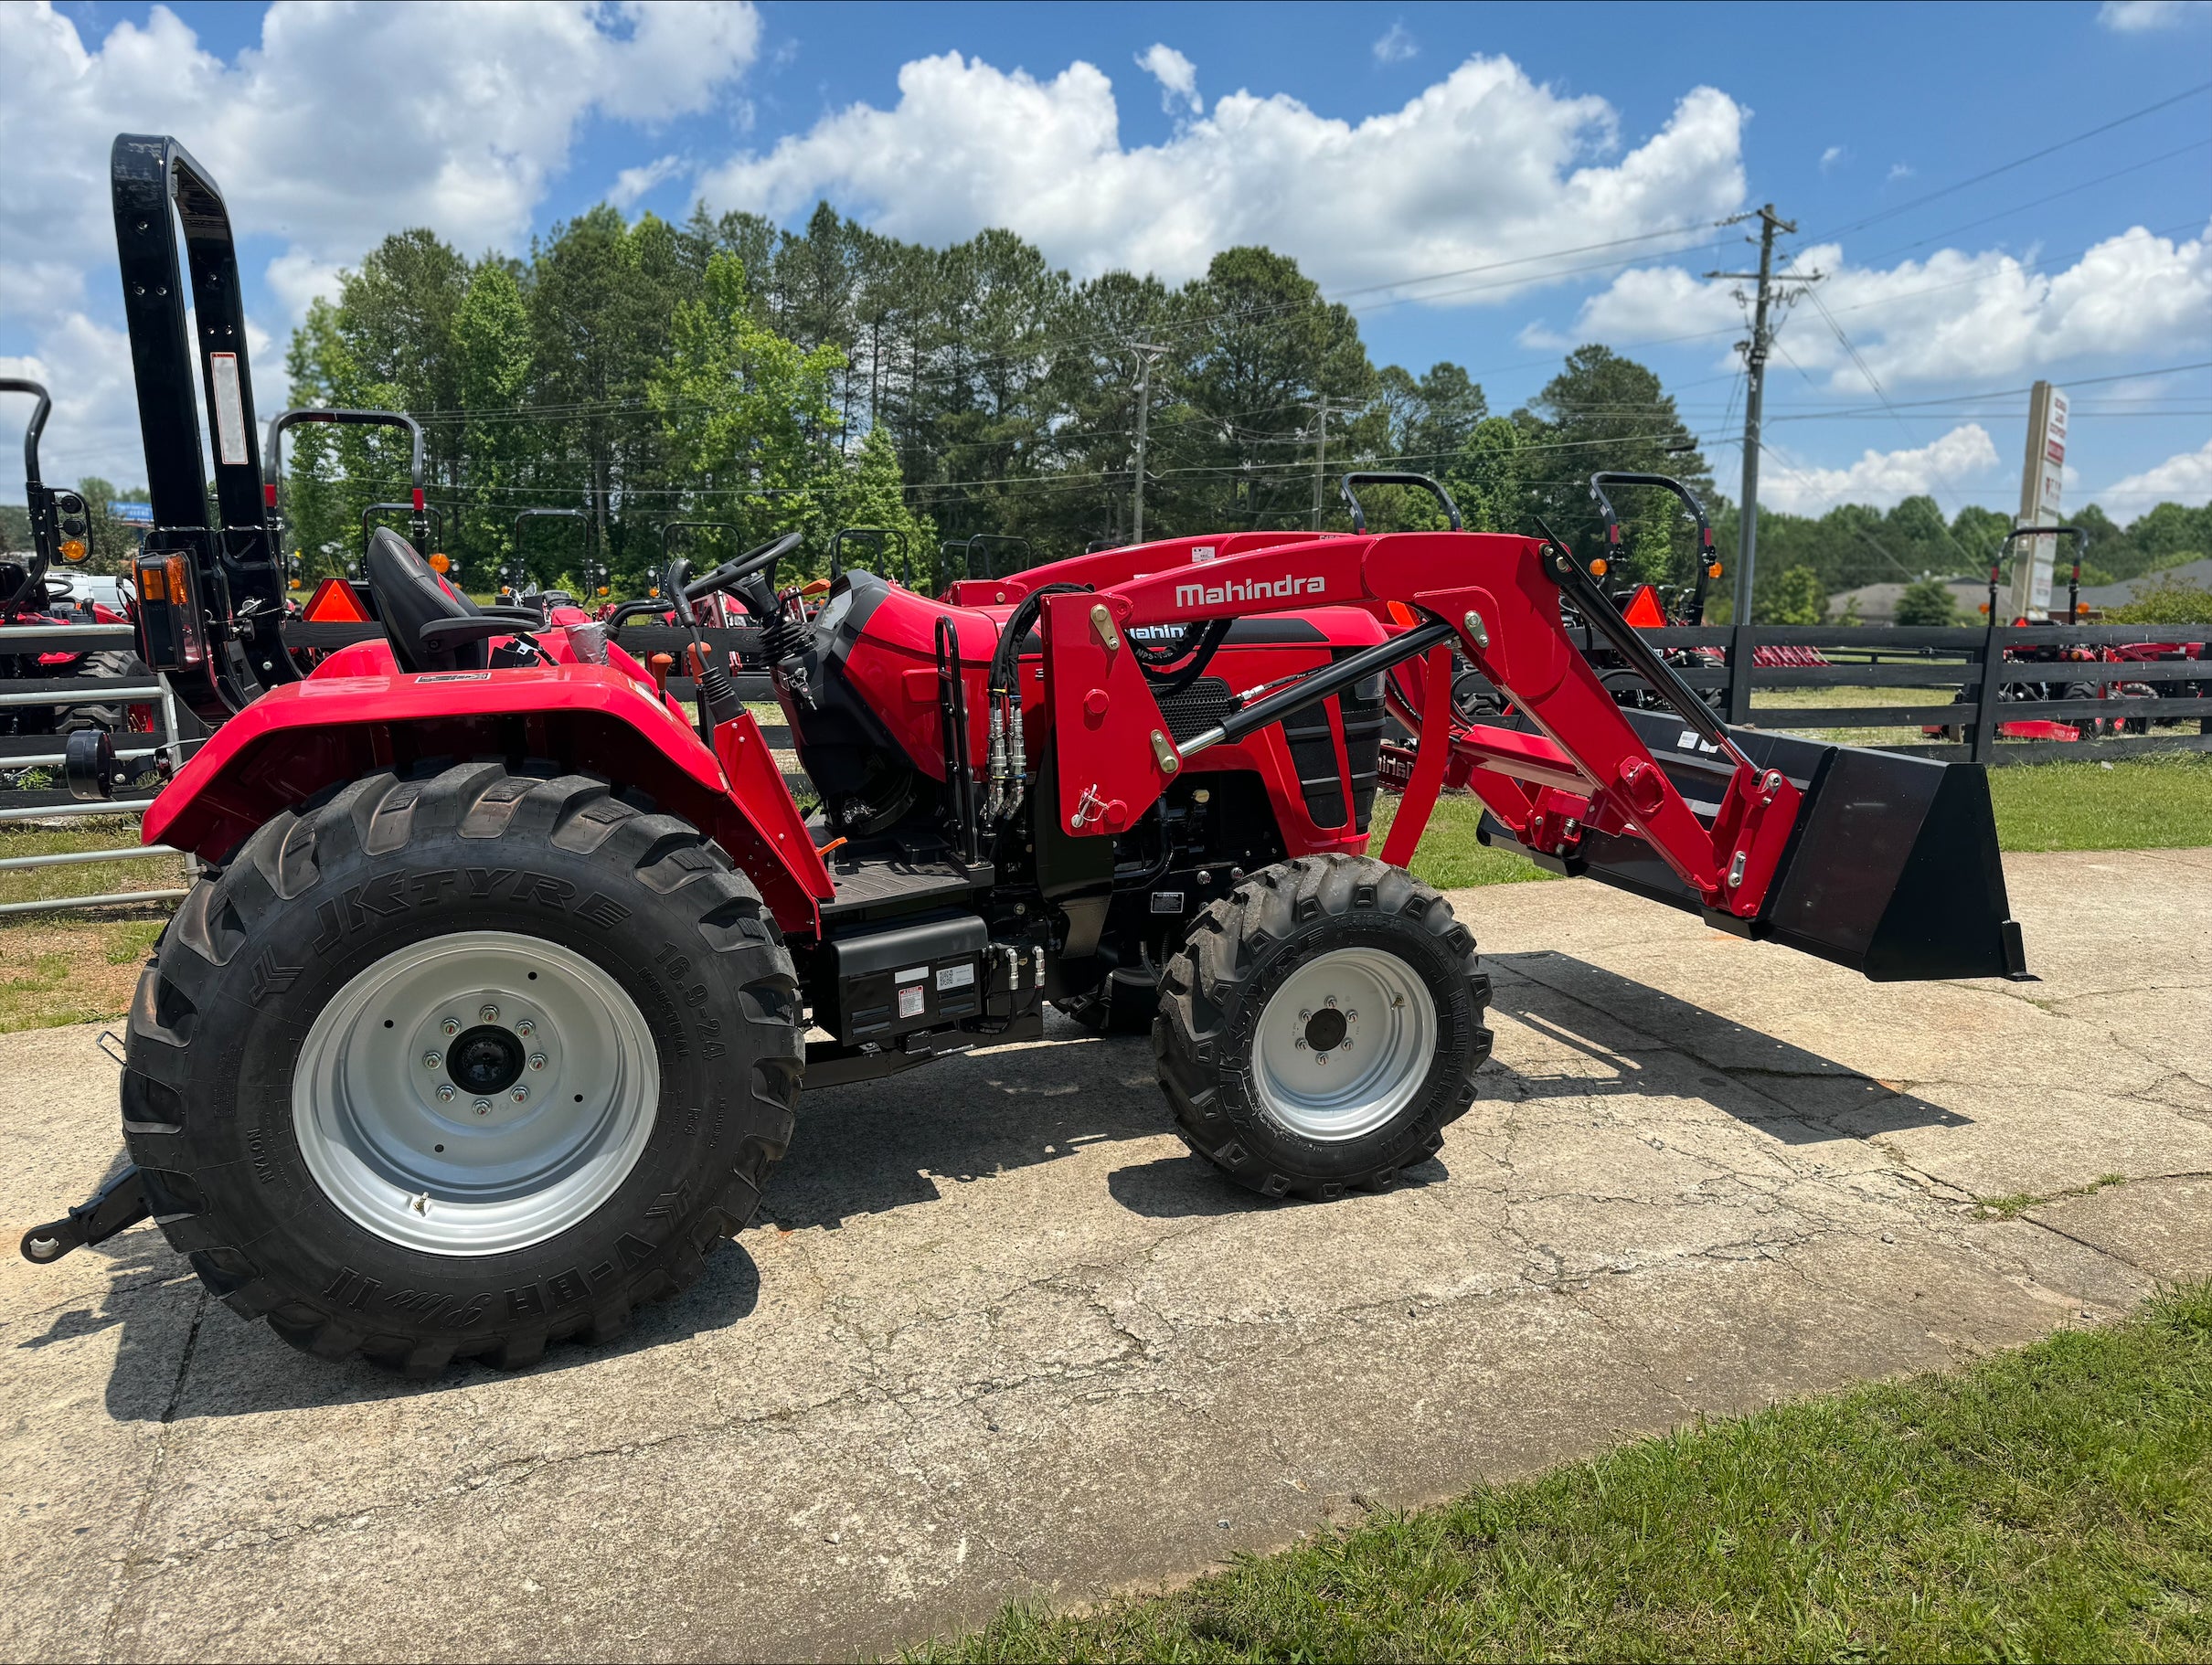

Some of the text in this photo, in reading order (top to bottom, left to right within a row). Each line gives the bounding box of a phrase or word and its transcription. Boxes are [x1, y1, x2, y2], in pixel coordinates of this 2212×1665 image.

[1175, 575, 1325, 607] Mahindra
[652, 940, 728, 1062] 16.9-24
[245, 1129, 273, 1184] NYLON
